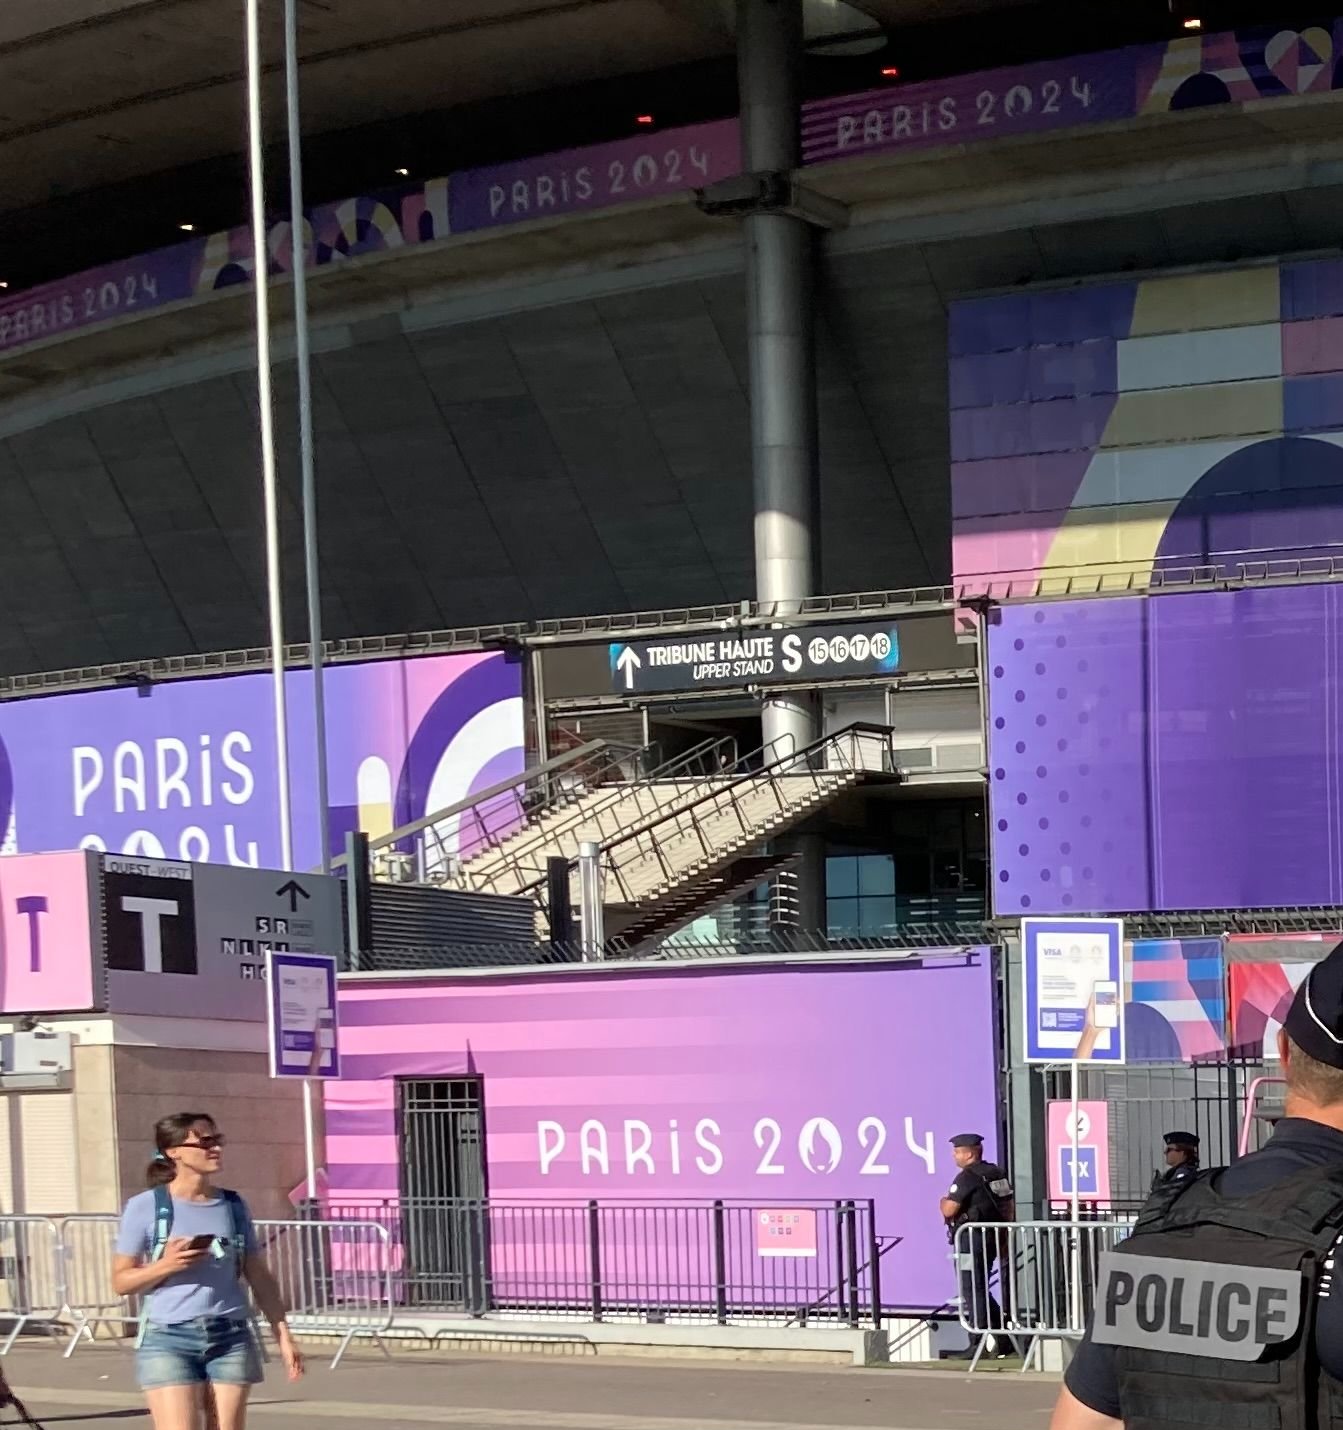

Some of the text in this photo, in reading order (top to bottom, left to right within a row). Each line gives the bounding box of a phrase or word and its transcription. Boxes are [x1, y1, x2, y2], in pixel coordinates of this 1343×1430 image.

[976, 77, 1090, 125] 2024
[608, 147, 708, 194] 2024
[84, 273, 159, 318] 2024
[646, 636, 774, 667] TRIBUNE HAUTE
[692, 658, 775, 681] UPPER STAND
[781, 633, 802, 673] S
[870, 636, 889, 657] 18
[15, 895, 49, 973] T
[120, 895, 179, 974] T
[223, 940, 235, 955] N
[243, 941, 252, 956] L
[258, 919, 268, 933] S
[276, 920, 287, 935] R
[242, 965, 254, 979] H
[1043, 948, 1062, 956] VISA
[753, 1116, 936, 1175] 2024
[1105, 1270, 1288, 1345] POLICE
